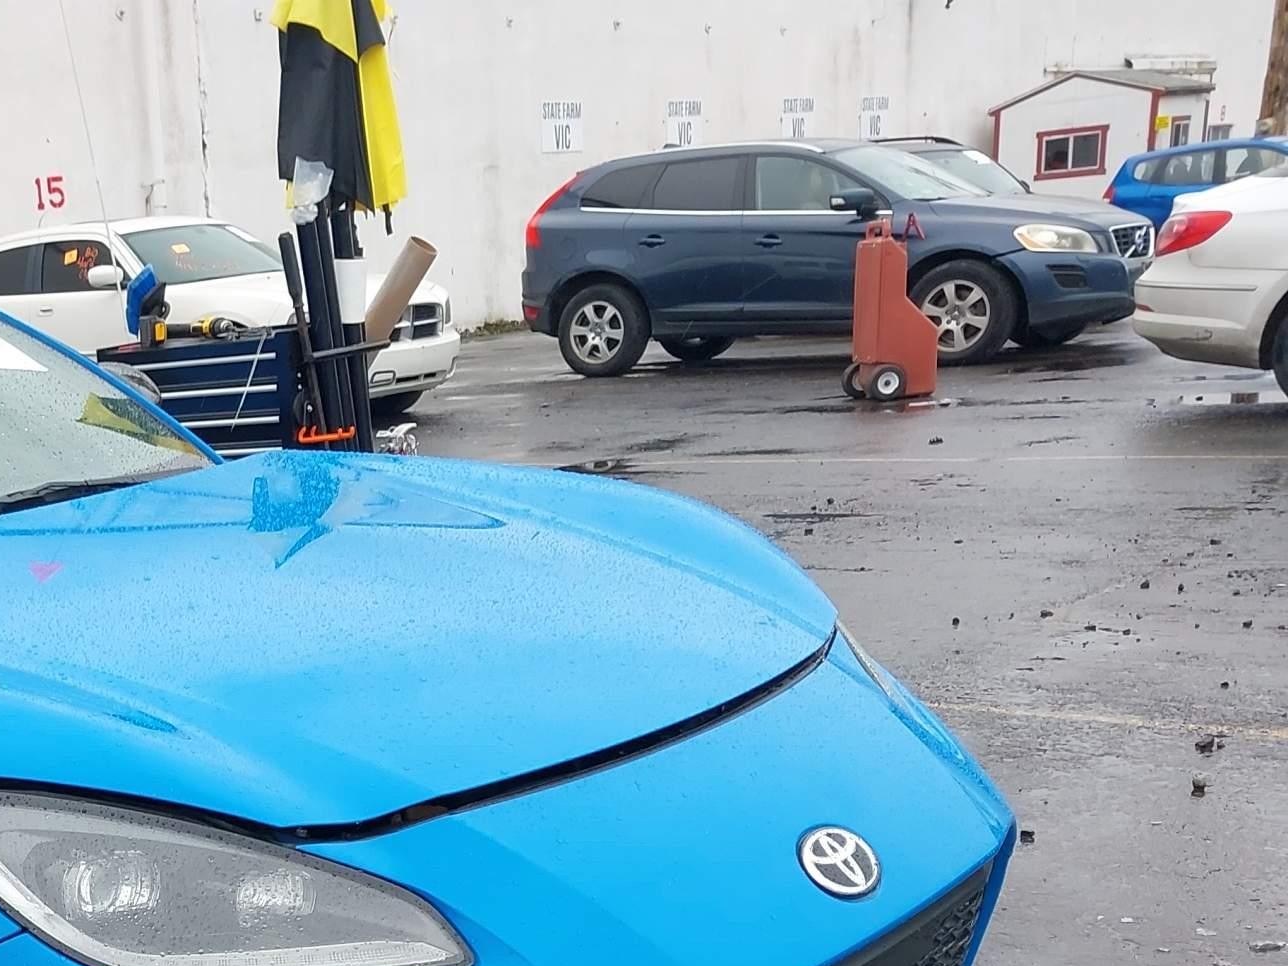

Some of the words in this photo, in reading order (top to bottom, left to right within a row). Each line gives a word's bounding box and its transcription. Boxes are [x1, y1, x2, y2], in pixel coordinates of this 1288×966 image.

[542, 102, 561, 120] STATE
[562, 102, 582, 119] FARM
[668, 101, 684, 118] STATE
[684, 101, 702, 117] FARM
[554, 124, 571, 150] VIC
[678, 121, 692, 145] VIC
[792, 118, 805, 137] VIC
[869, 115, 881, 137] VIC
[35, 175, 65, 210] 15
